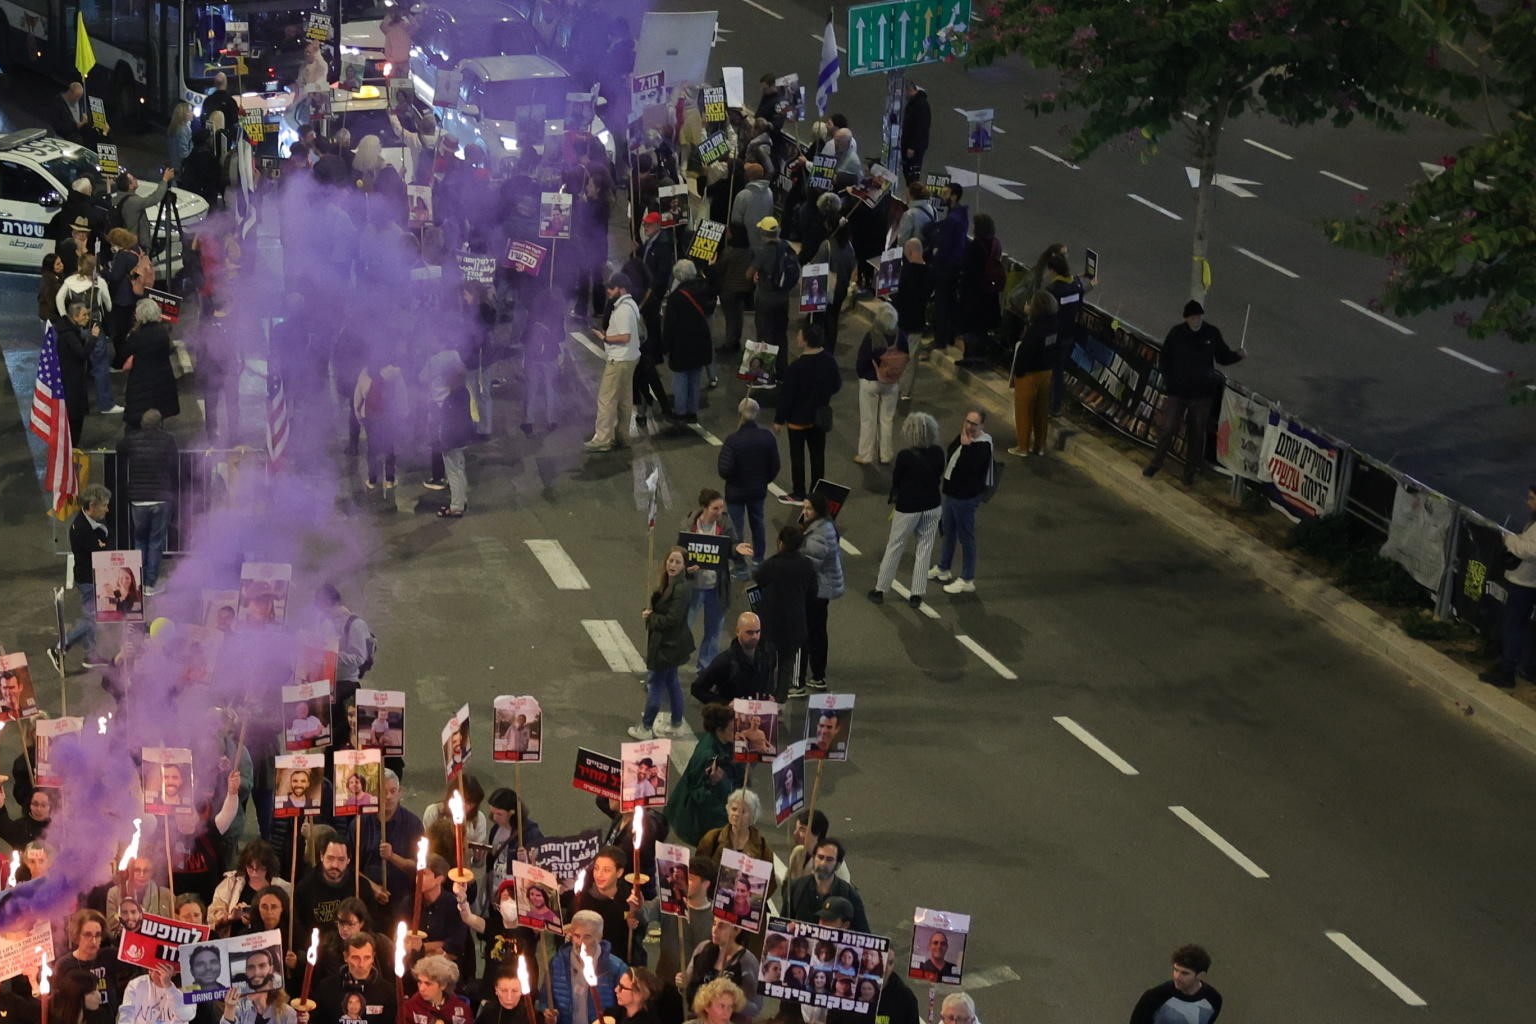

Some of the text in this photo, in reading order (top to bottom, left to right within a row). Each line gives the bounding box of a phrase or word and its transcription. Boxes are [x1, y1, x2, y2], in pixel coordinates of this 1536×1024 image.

[638, 76, 658, 91] 7.10
[688, 542, 720, 555] עסקה
[585, 758, 609, 772] שבויים
[540, 836, 599, 856] די למלחמה
[551, 862, 580, 872] STOP
[140, 924, 208, 949] לחופש
[793, 920, 887, 950] זועקות בשבילן
[764, 982, 869, 1014] עסקה היום!
